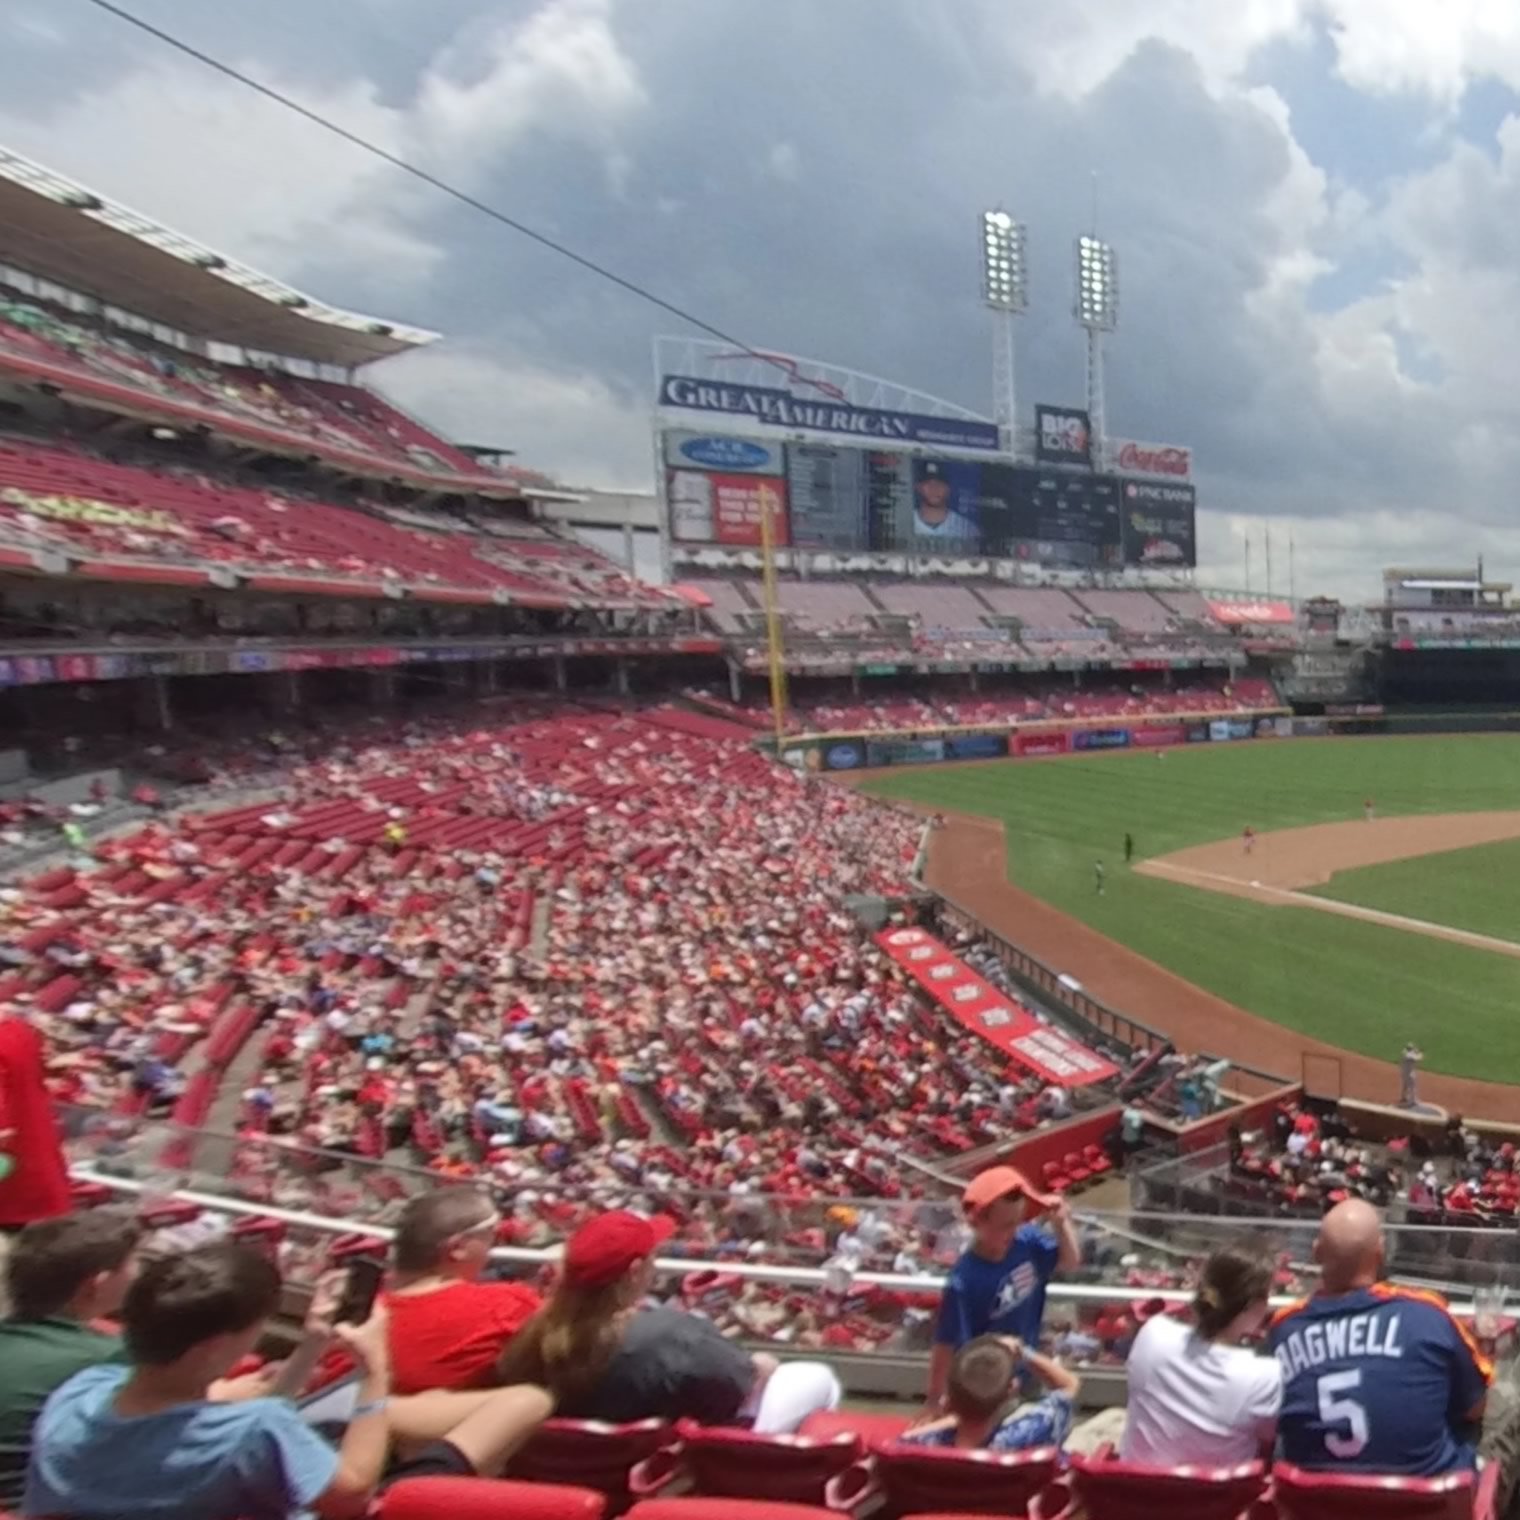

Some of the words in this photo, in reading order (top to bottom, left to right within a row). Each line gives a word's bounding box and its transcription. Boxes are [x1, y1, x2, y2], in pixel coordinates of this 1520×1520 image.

[667, 378, 773, 414] GREAT
[768, 401, 909, 435] AMERICAN
[1317, 1367, 1369, 1459] 5
